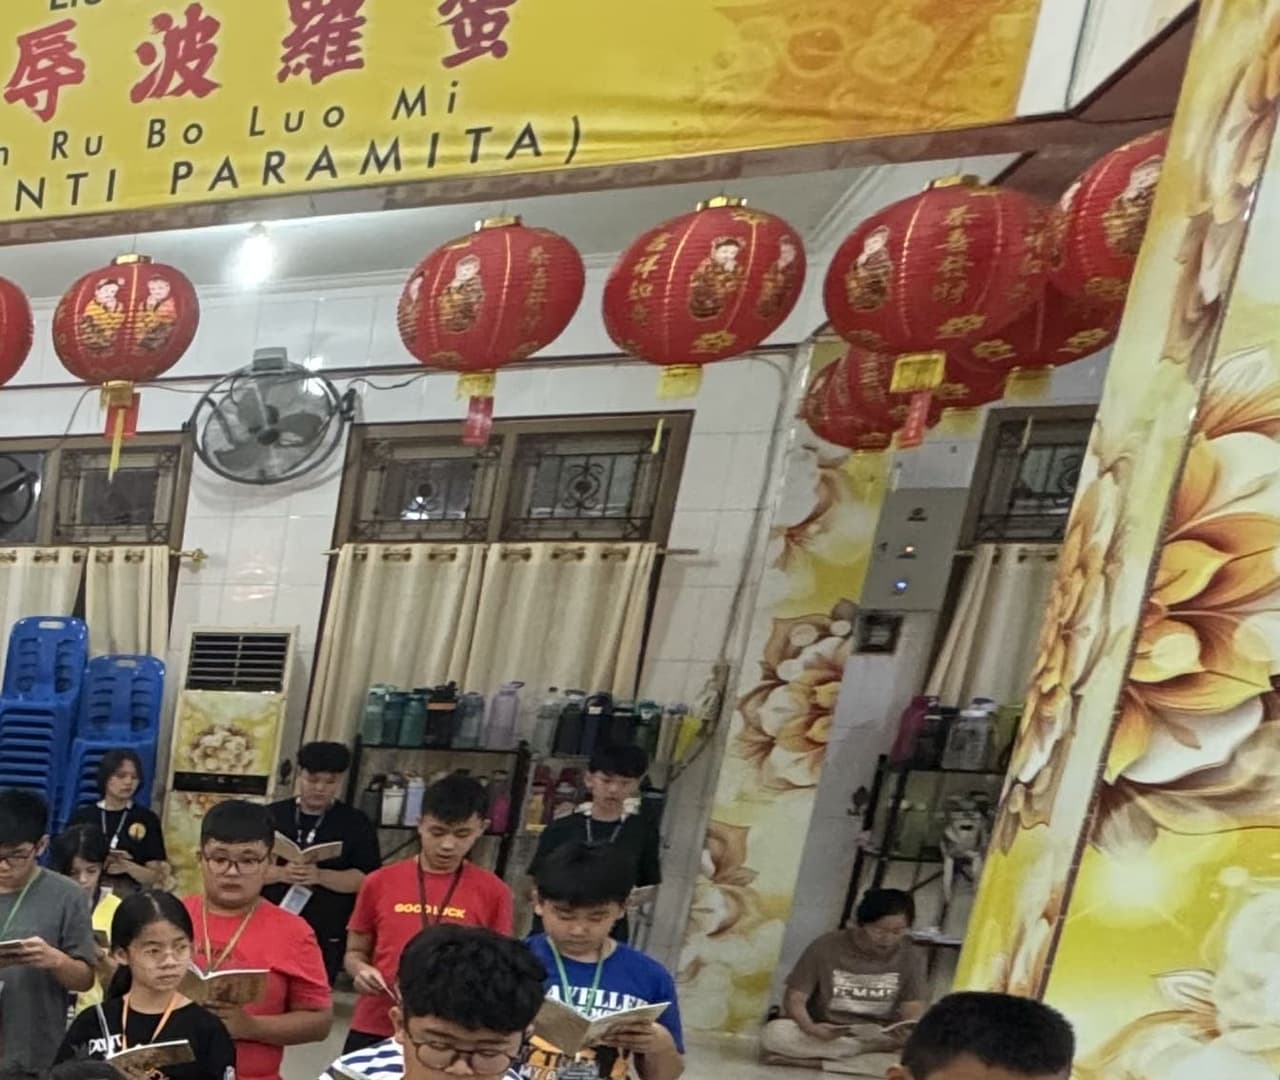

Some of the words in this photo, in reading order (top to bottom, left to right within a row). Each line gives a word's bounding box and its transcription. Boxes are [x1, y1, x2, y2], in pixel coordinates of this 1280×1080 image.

[51, 131, 103, 160] Ru
[147, 118, 203, 149] Bo
[249, 105, 344, 137] Luo
[391, 80, 459, 120] Mi
[170, 115, 581, 195] PARAMITA)
